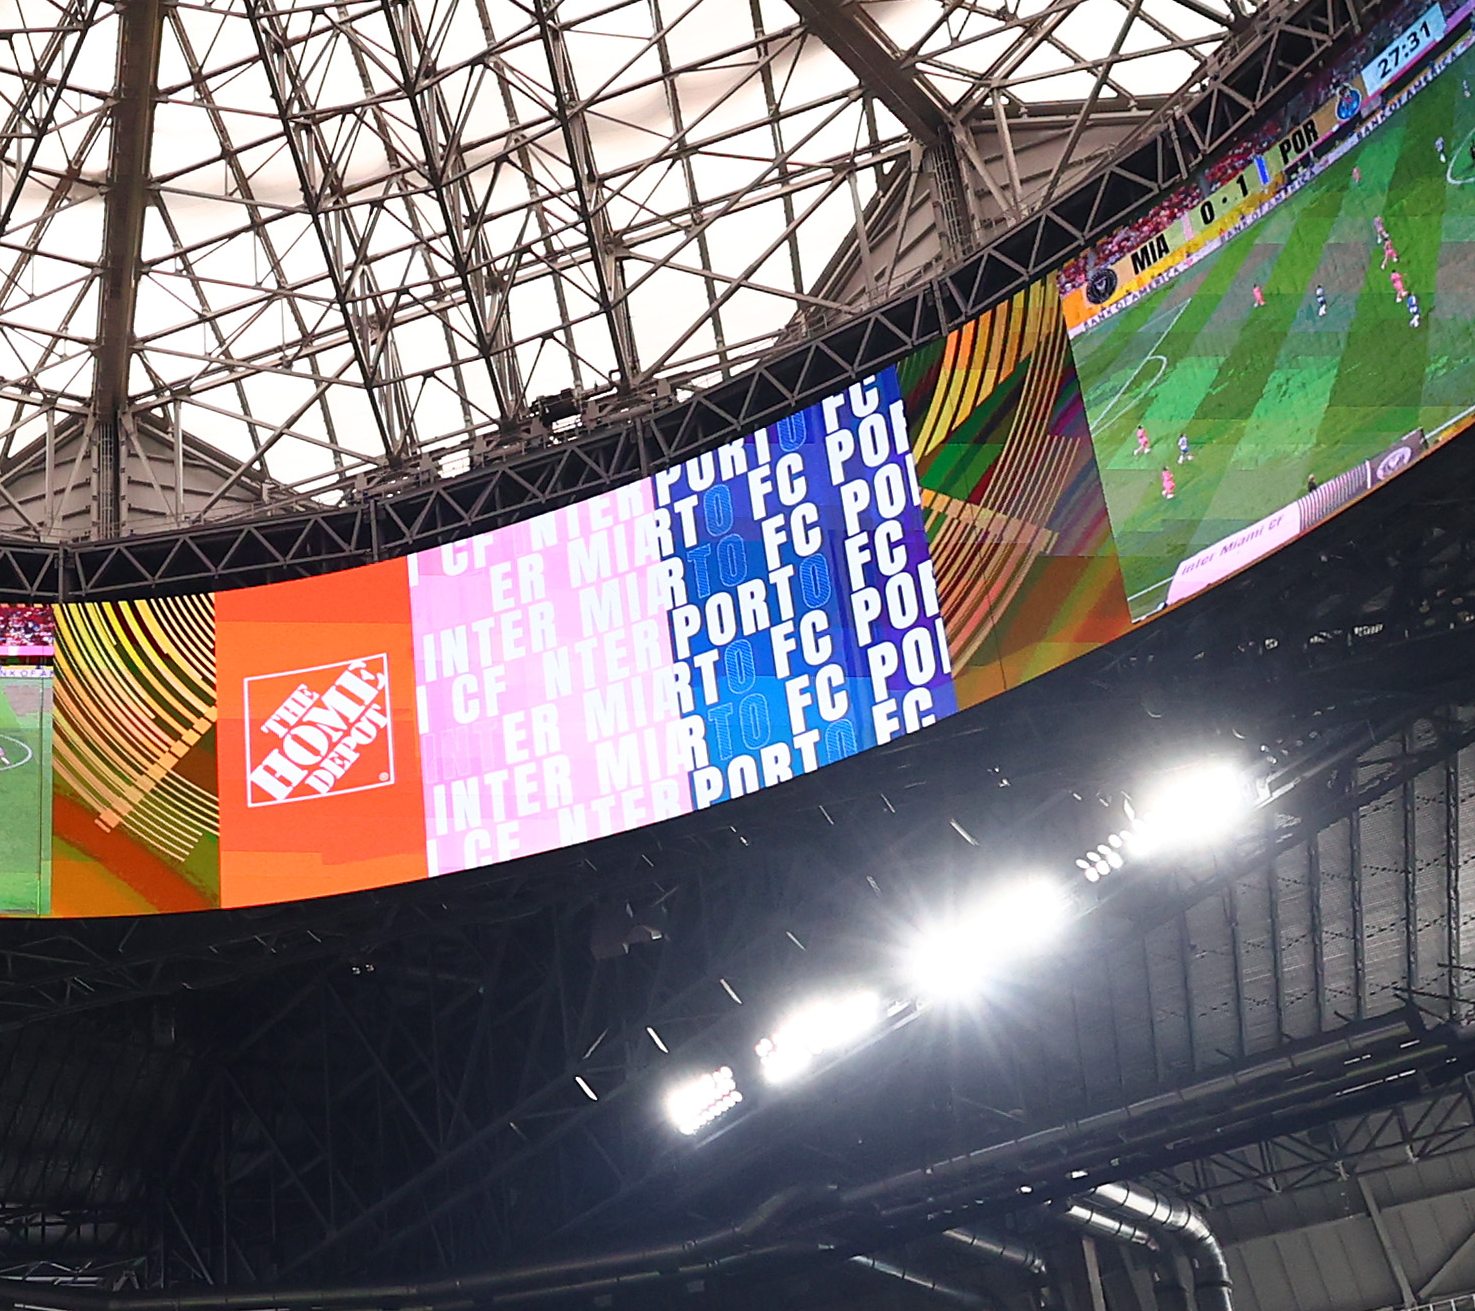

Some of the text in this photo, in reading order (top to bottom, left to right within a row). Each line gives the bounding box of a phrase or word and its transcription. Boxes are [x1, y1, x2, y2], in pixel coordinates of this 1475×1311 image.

[1378, 20, 1431, 79] 27:31
[1278, 119, 1318, 164] POR
[1200, 174, 1249, 225] 0 1
[1130, 234, 1170, 275] MIA
[748, 452, 808, 521] FC
[423, 600, 558, 682] INTER
[762, 502, 822, 571] FC
[452, 665, 506, 724] CF
[845, 520, 909, 592] FC
[770, 610, 832, 679] FC
[250, 660, 385, 801] HOME
[260, 684, 320, 738] THE
[304, 703, 388, 794] DEPOT
[433, 754, 573, 837] INTER
[786, 664, 848, 735] FC
